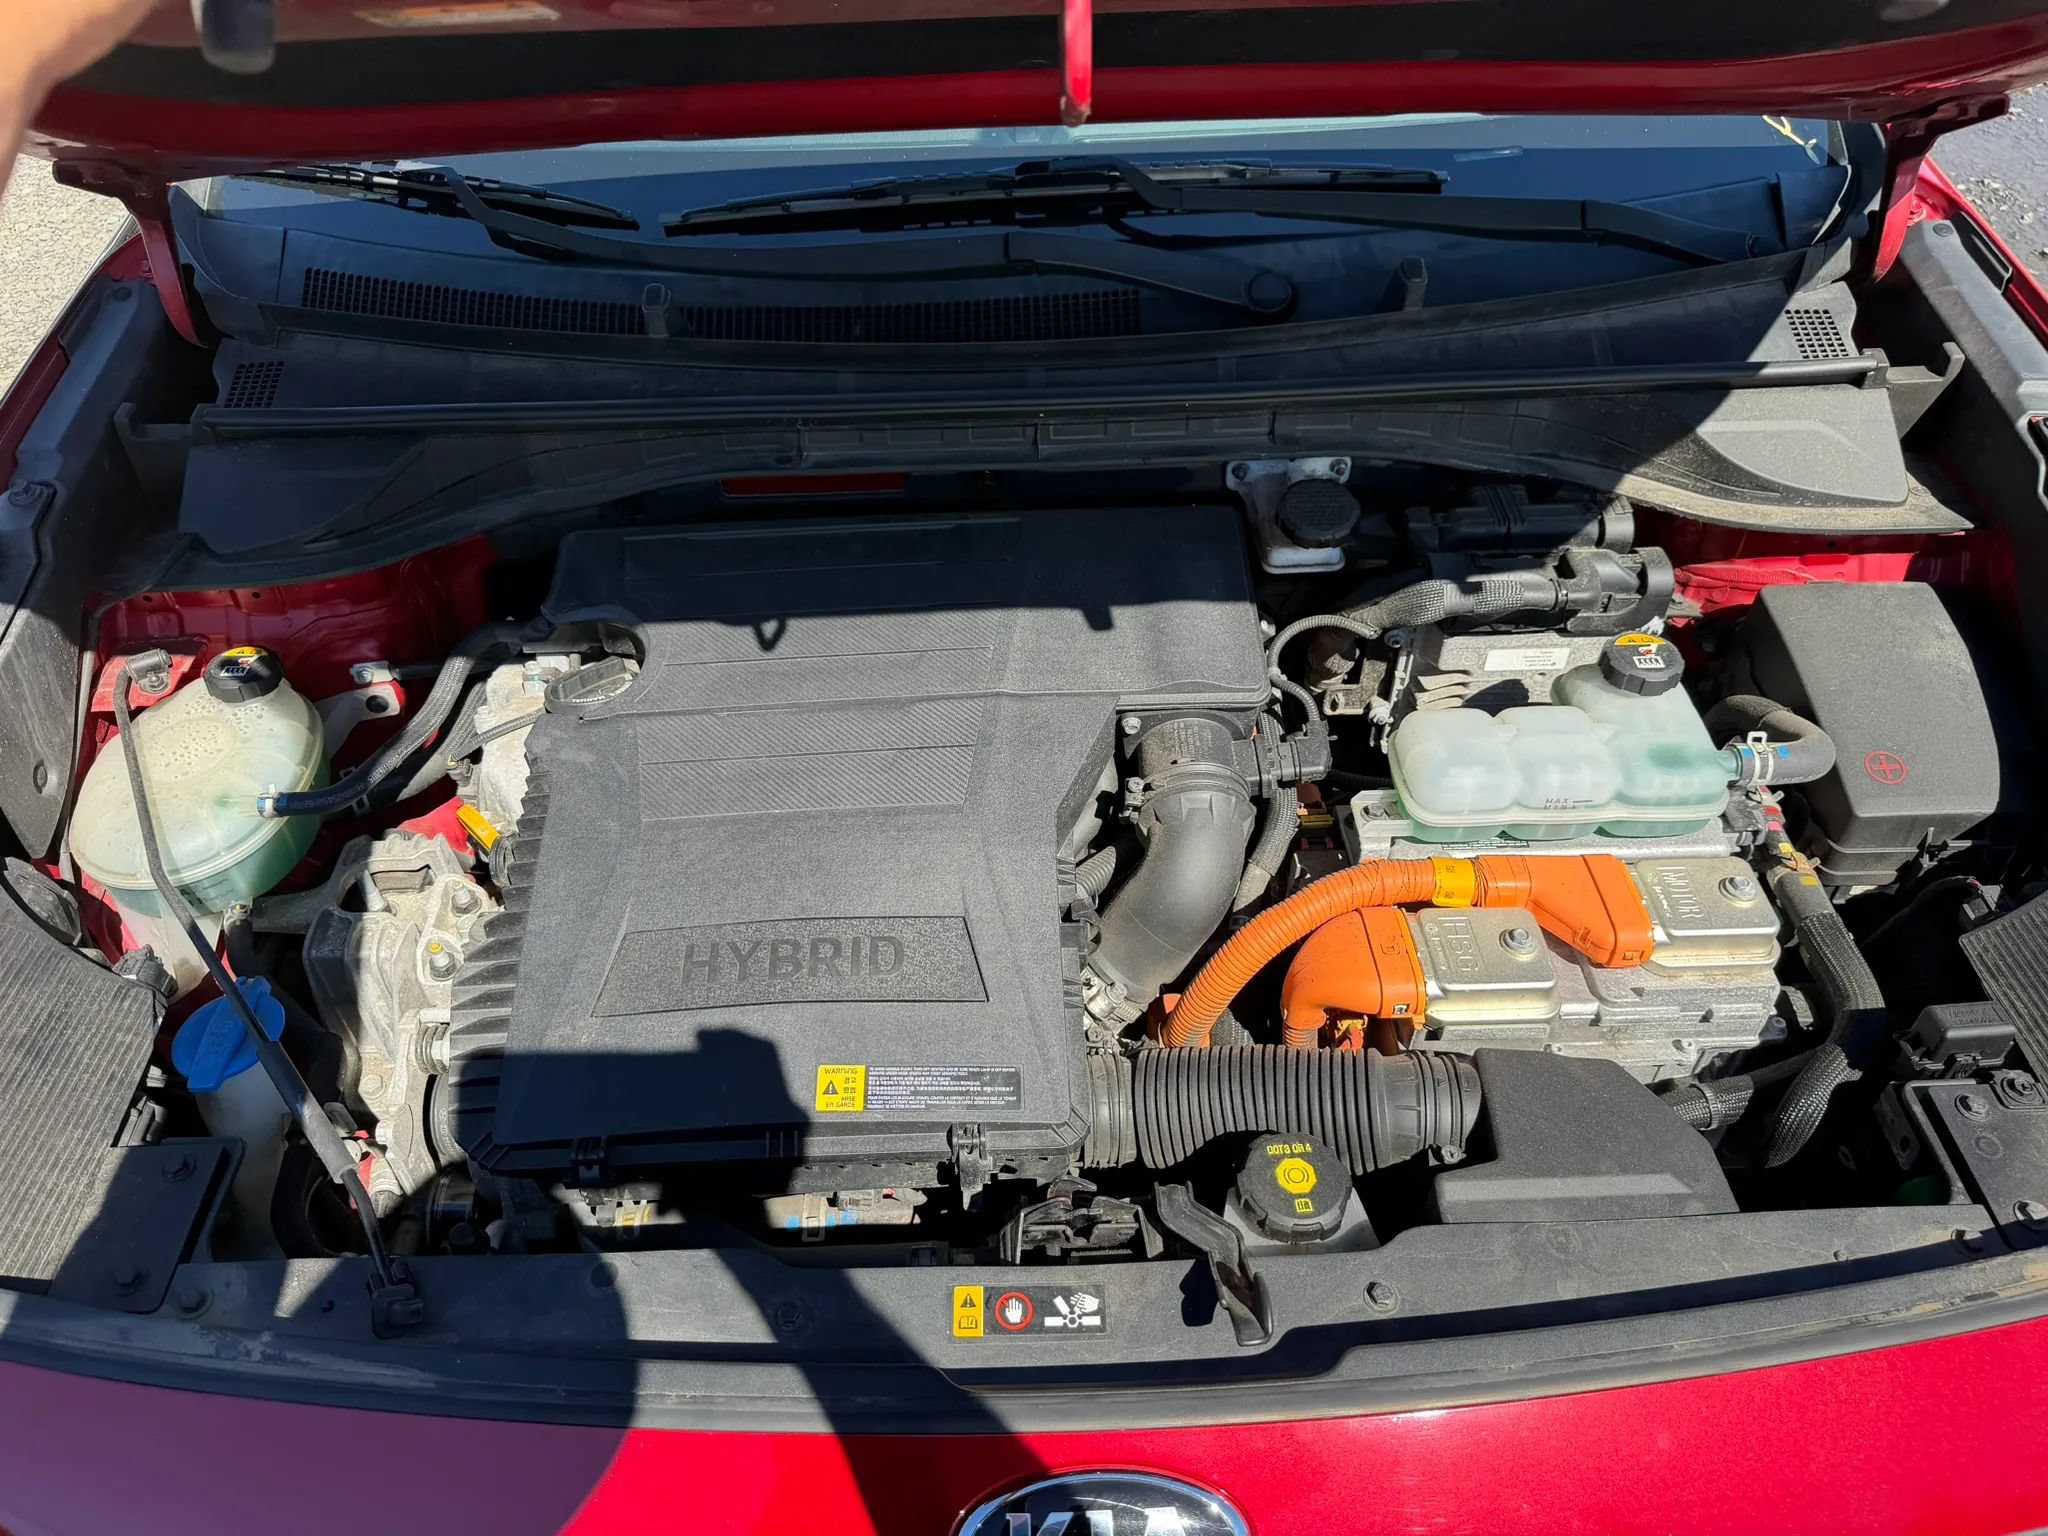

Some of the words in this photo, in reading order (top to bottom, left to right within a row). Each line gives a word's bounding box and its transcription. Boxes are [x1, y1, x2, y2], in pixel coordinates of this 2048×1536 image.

[682, 935, 905, 987] HYBRID
[1442, 922, 1479, 972] HSG
[824, 1067, 858, 1075] WARNING
[1266, 1144, 1291, 1155] DOT3
[1291, 1143, 1305, 1153] OR
